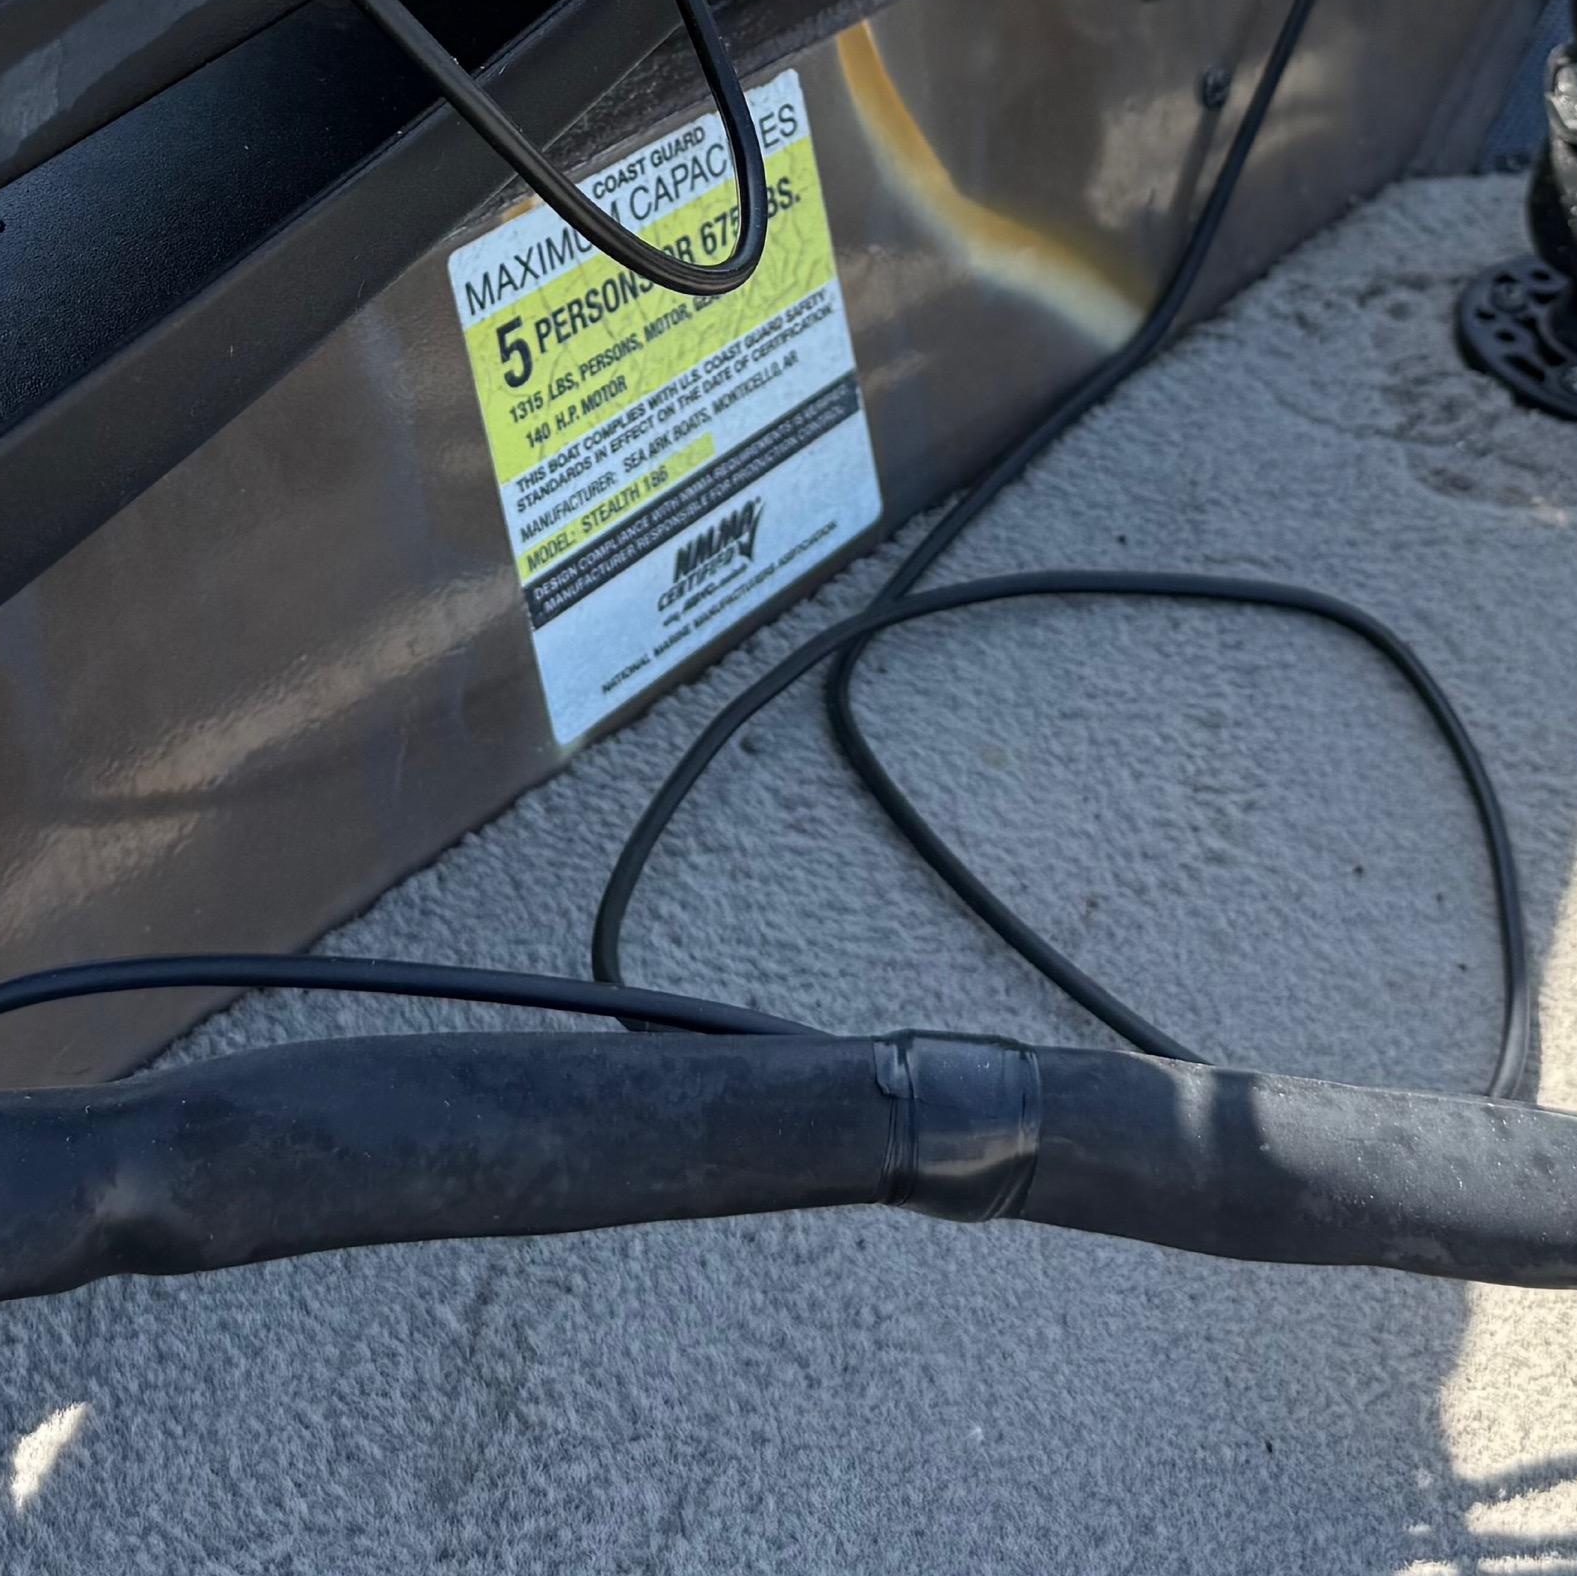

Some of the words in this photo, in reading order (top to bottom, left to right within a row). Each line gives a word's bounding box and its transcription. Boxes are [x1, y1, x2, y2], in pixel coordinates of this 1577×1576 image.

[592, 159, 646, 200] COAST
[649, 126, 705, 168] GUARD
[628, 102, 797, 222] CAPACES
[495, 316, 535, 391] 5
[517, 467, 545, 493] THIS
[548, 444, 580, 473] BOAT
[583, 404, 645, 452] COMPLIES
[648, 383, 677, 410] WITH
[703, 343, 742, 375] COAST
[744, 316, 783, 349] GUARD
[785, 289, 825, 322] SAFETY
[509, 392, 543, 424] 1315
[516, 457, 592, 513] STANDARDS
[595, 447, 607, 463] IN
[610, 418, 653, 453] EFFECT
[657, 404, 674, 423] ON
[678, 387, 700, 409] THE
[702, 367, 732, 394] DATE
[733, 356, 749, 373] OF
[520, 469, 617, 543] MANUFACTURER:
[623, 449, 645, 474] SEA
[647, 432, 670, 457] ARK
[782, 349, 798, 370] AR
[526, 422, 551, 449] 140
[555, 404, 578, 430] H.P.
[580, 374, 627, 415] MOTOR
[526, 529, 576, 572] MODEL:
[581, 484, 640, 534] STEALTH
[534, 564, 576, 600] DESIGN
[578, 516, 649, 571] COMPLIANCE
[674, 495, 756, 583] NMMA
